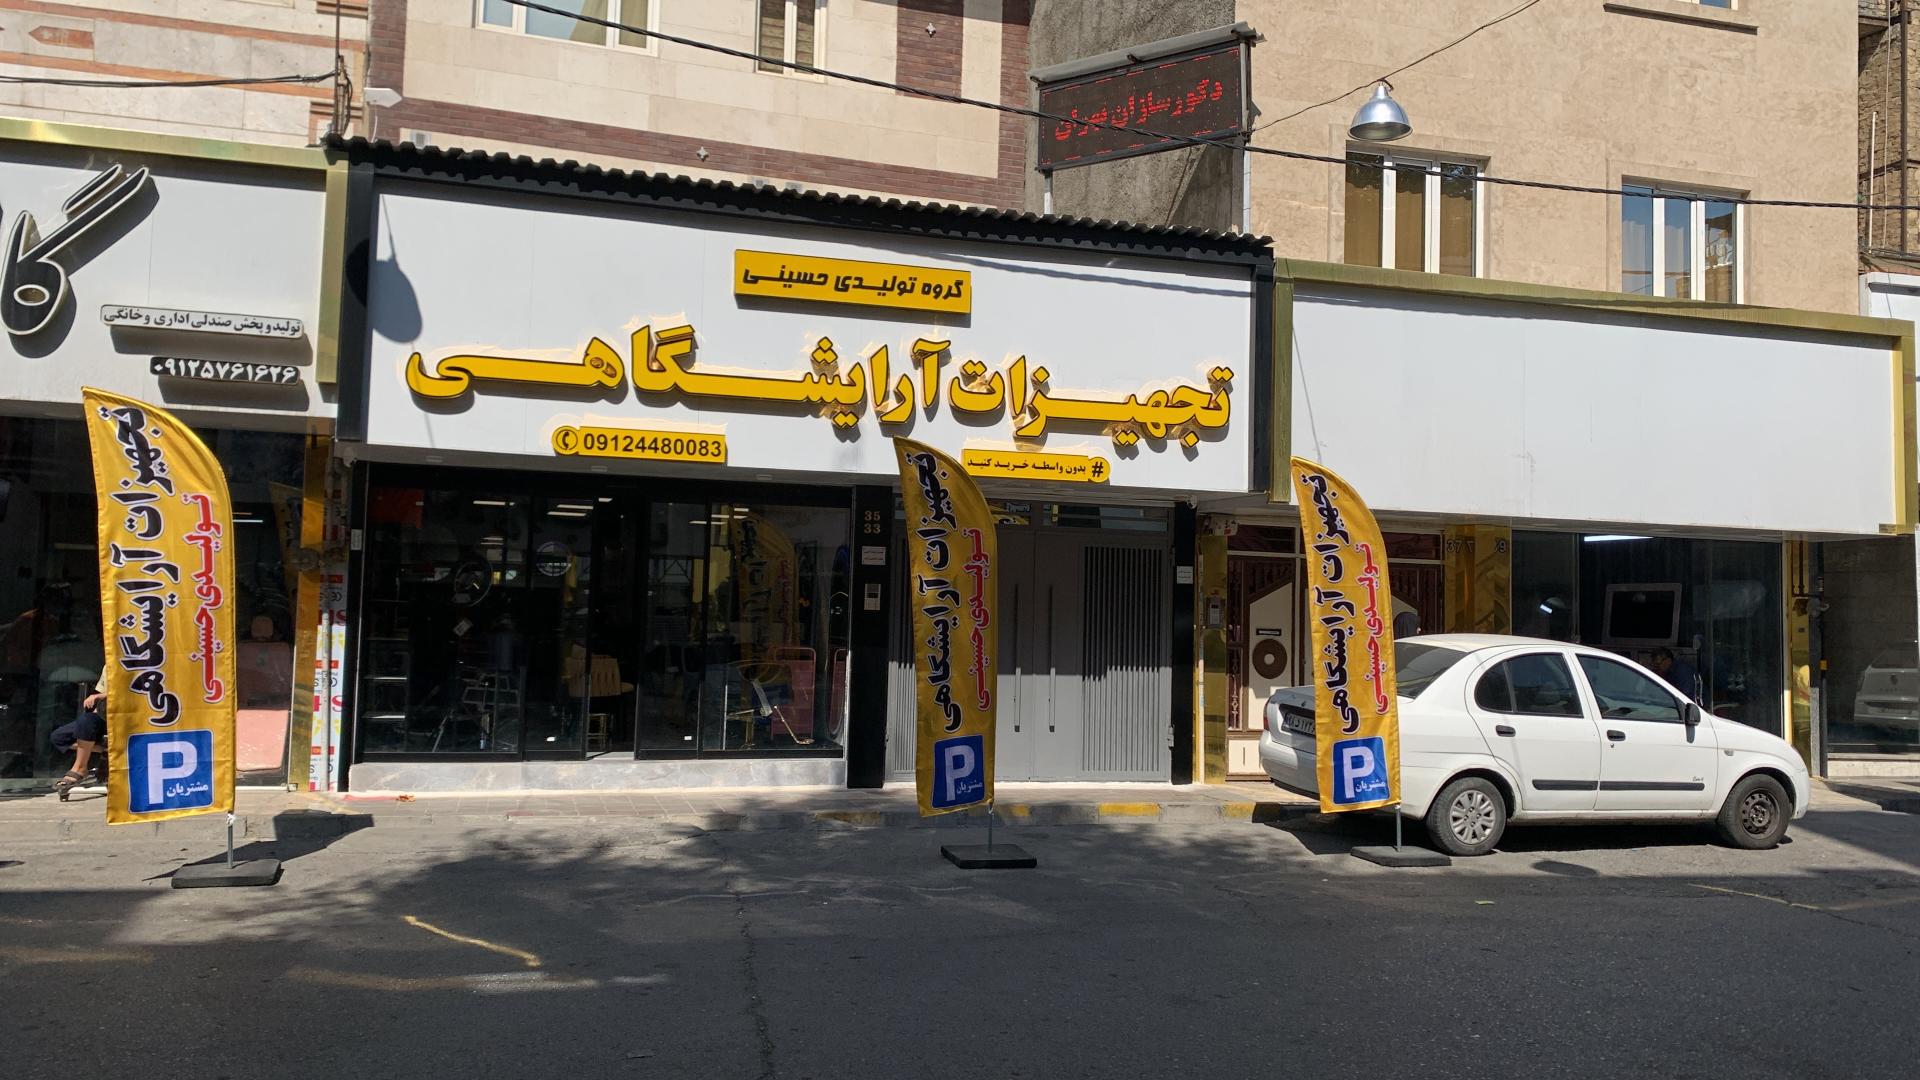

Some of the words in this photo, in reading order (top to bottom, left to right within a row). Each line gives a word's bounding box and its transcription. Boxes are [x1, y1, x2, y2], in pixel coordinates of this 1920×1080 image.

[742, 264, 829, 288] حسینی
[833, 271, 917, 297] تولیدی
[921, 278, 963, 301] گروه
[144, 312, 151, 325] و
[153, 312, 191, 329] اداری
[190, 312, 232, 331] صندلی
[233, 318, 265, 336] پخش
[273, 320, 302, 337] تولید
[405, 324, 950, 429] آرایشگاهی
[949, 354, 1231, 447] تجهیزات
[583, 433, 723, 458] 09124480083
[98, 406, 175, 541] تجهیزات
[967, 458, 994, 471] کنید
[998, 460, 1029, 474] خرید
[1031, 460, 1064, 476] واسطه
[1064, 464, 1087, 478] بدون
[1091, 462, 1104, 477] #
[864, 510, 880, 521] 35
[905, 452, 957, 571] تجهیزات
[864, 523, 880, 534] 33
[1301, 474, 1350, 583] تجهیزات
[180, 492, 224, 610] تولیدی
[962, 527, 990, 630] تولیدی
[1356, 543, 1384, 636] تولیدی
[109, 541, 182, 728] آرایشگاهی
[190, 606, 226, 705] حسینی
[917, 573, 962, 733] آرایشگاهی
[1313, 585, 1360, 735] آرایشگاهی
[967, 625, 992, 711] حسینی
[1364, 632, 1389, 714] حسینی
[147, 740, 199, 806] P
[945, 745, 975, 801] P
[1343, 746, 1375, 798] P
[166, 781, 209, 798] مشتریان
[1355, 778, 1387, 793] مشتریان
